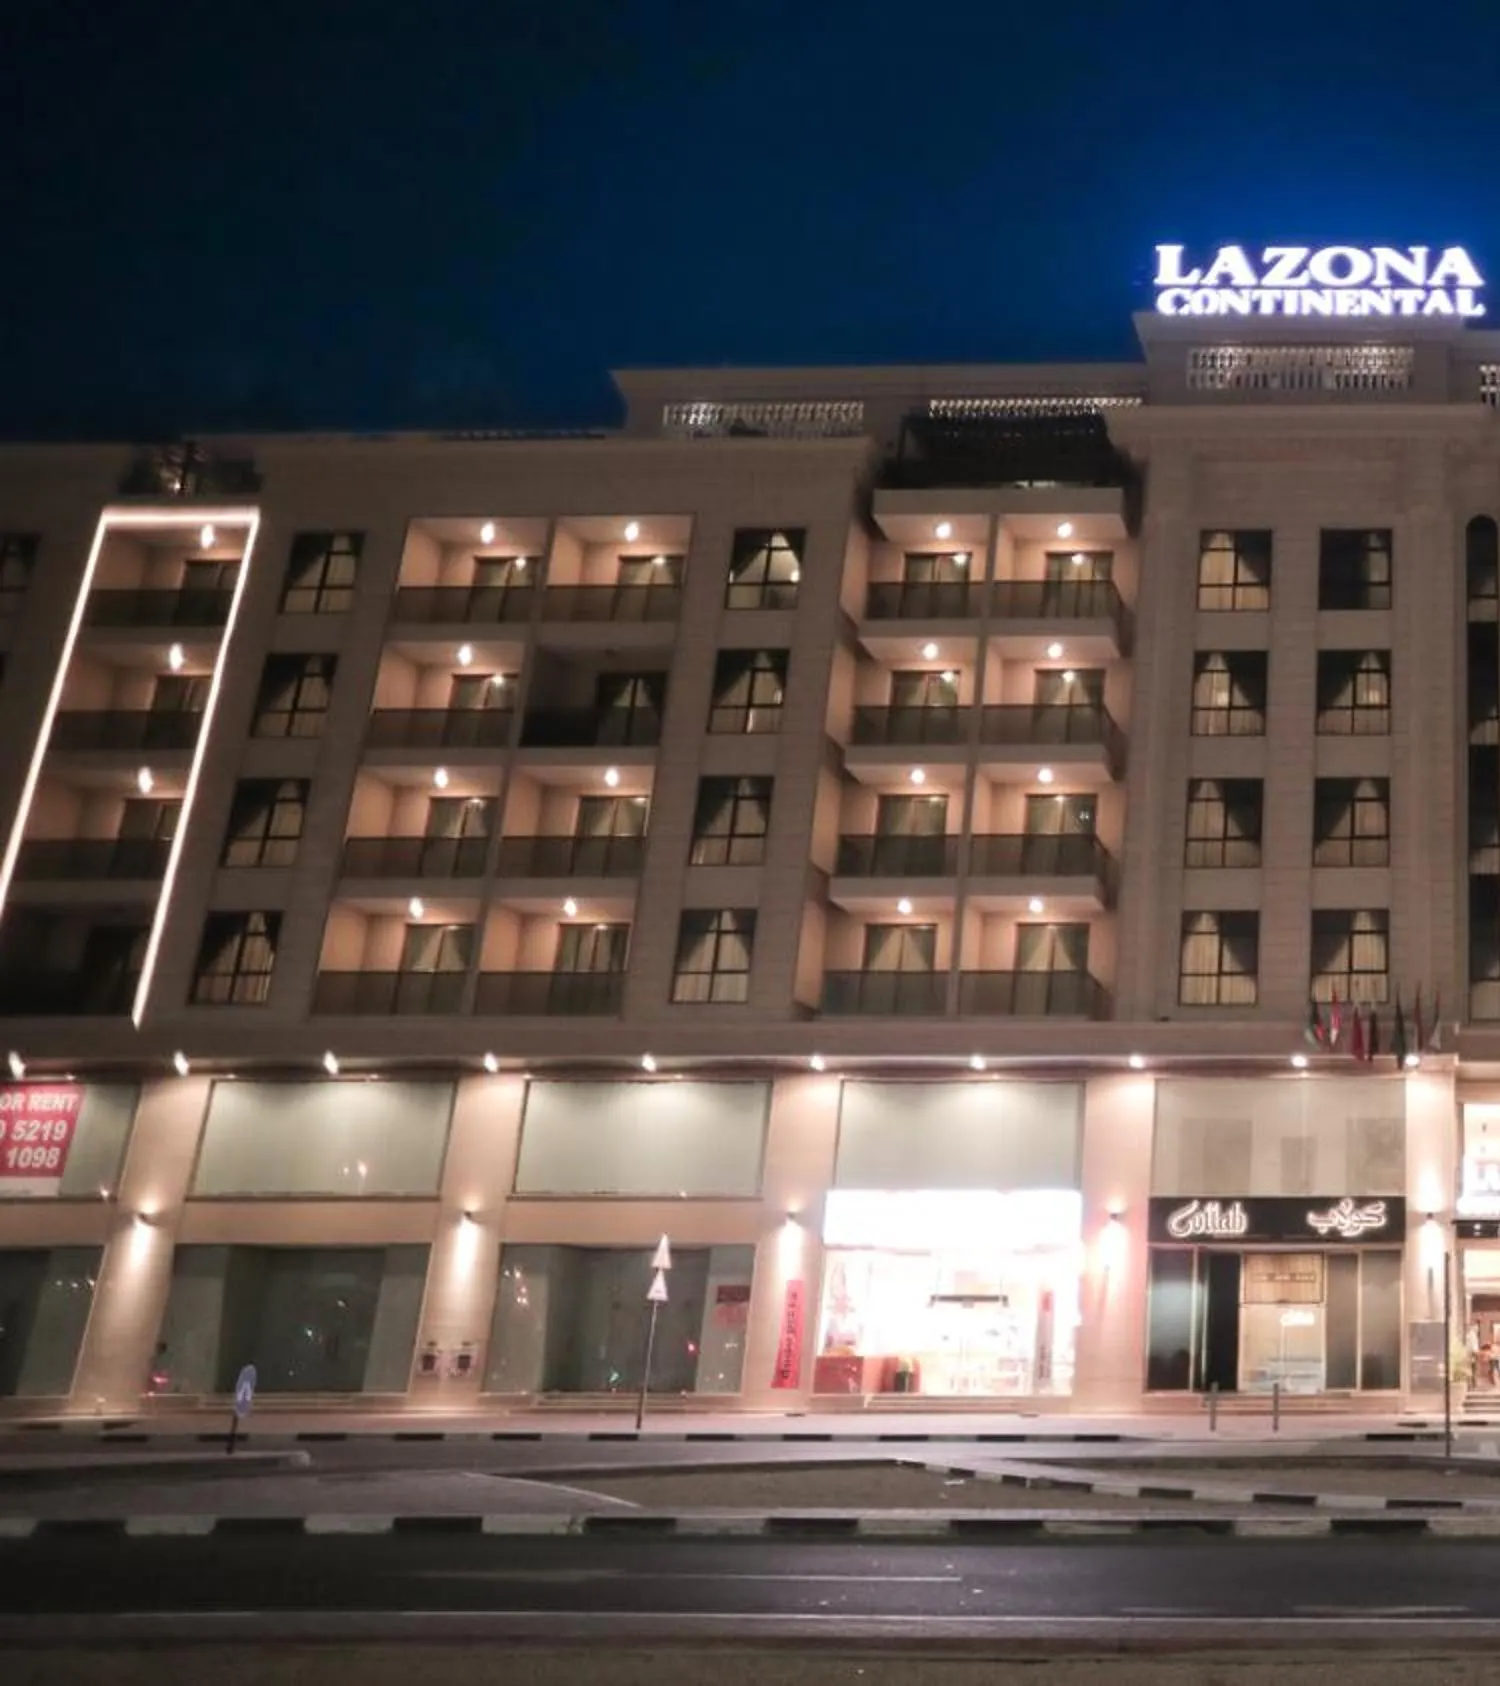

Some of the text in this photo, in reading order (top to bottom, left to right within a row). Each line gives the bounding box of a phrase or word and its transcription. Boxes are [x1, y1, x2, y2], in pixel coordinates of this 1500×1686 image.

[1154, 244, 1484, 287] LAZONA
[1156, 288, 1486, 316] CONTINENTAL
[27, 1092, 79, 1112] RENT
[11, 1119, 68, 1142] 5219
[7, 1147, 60, 1169] 1098
